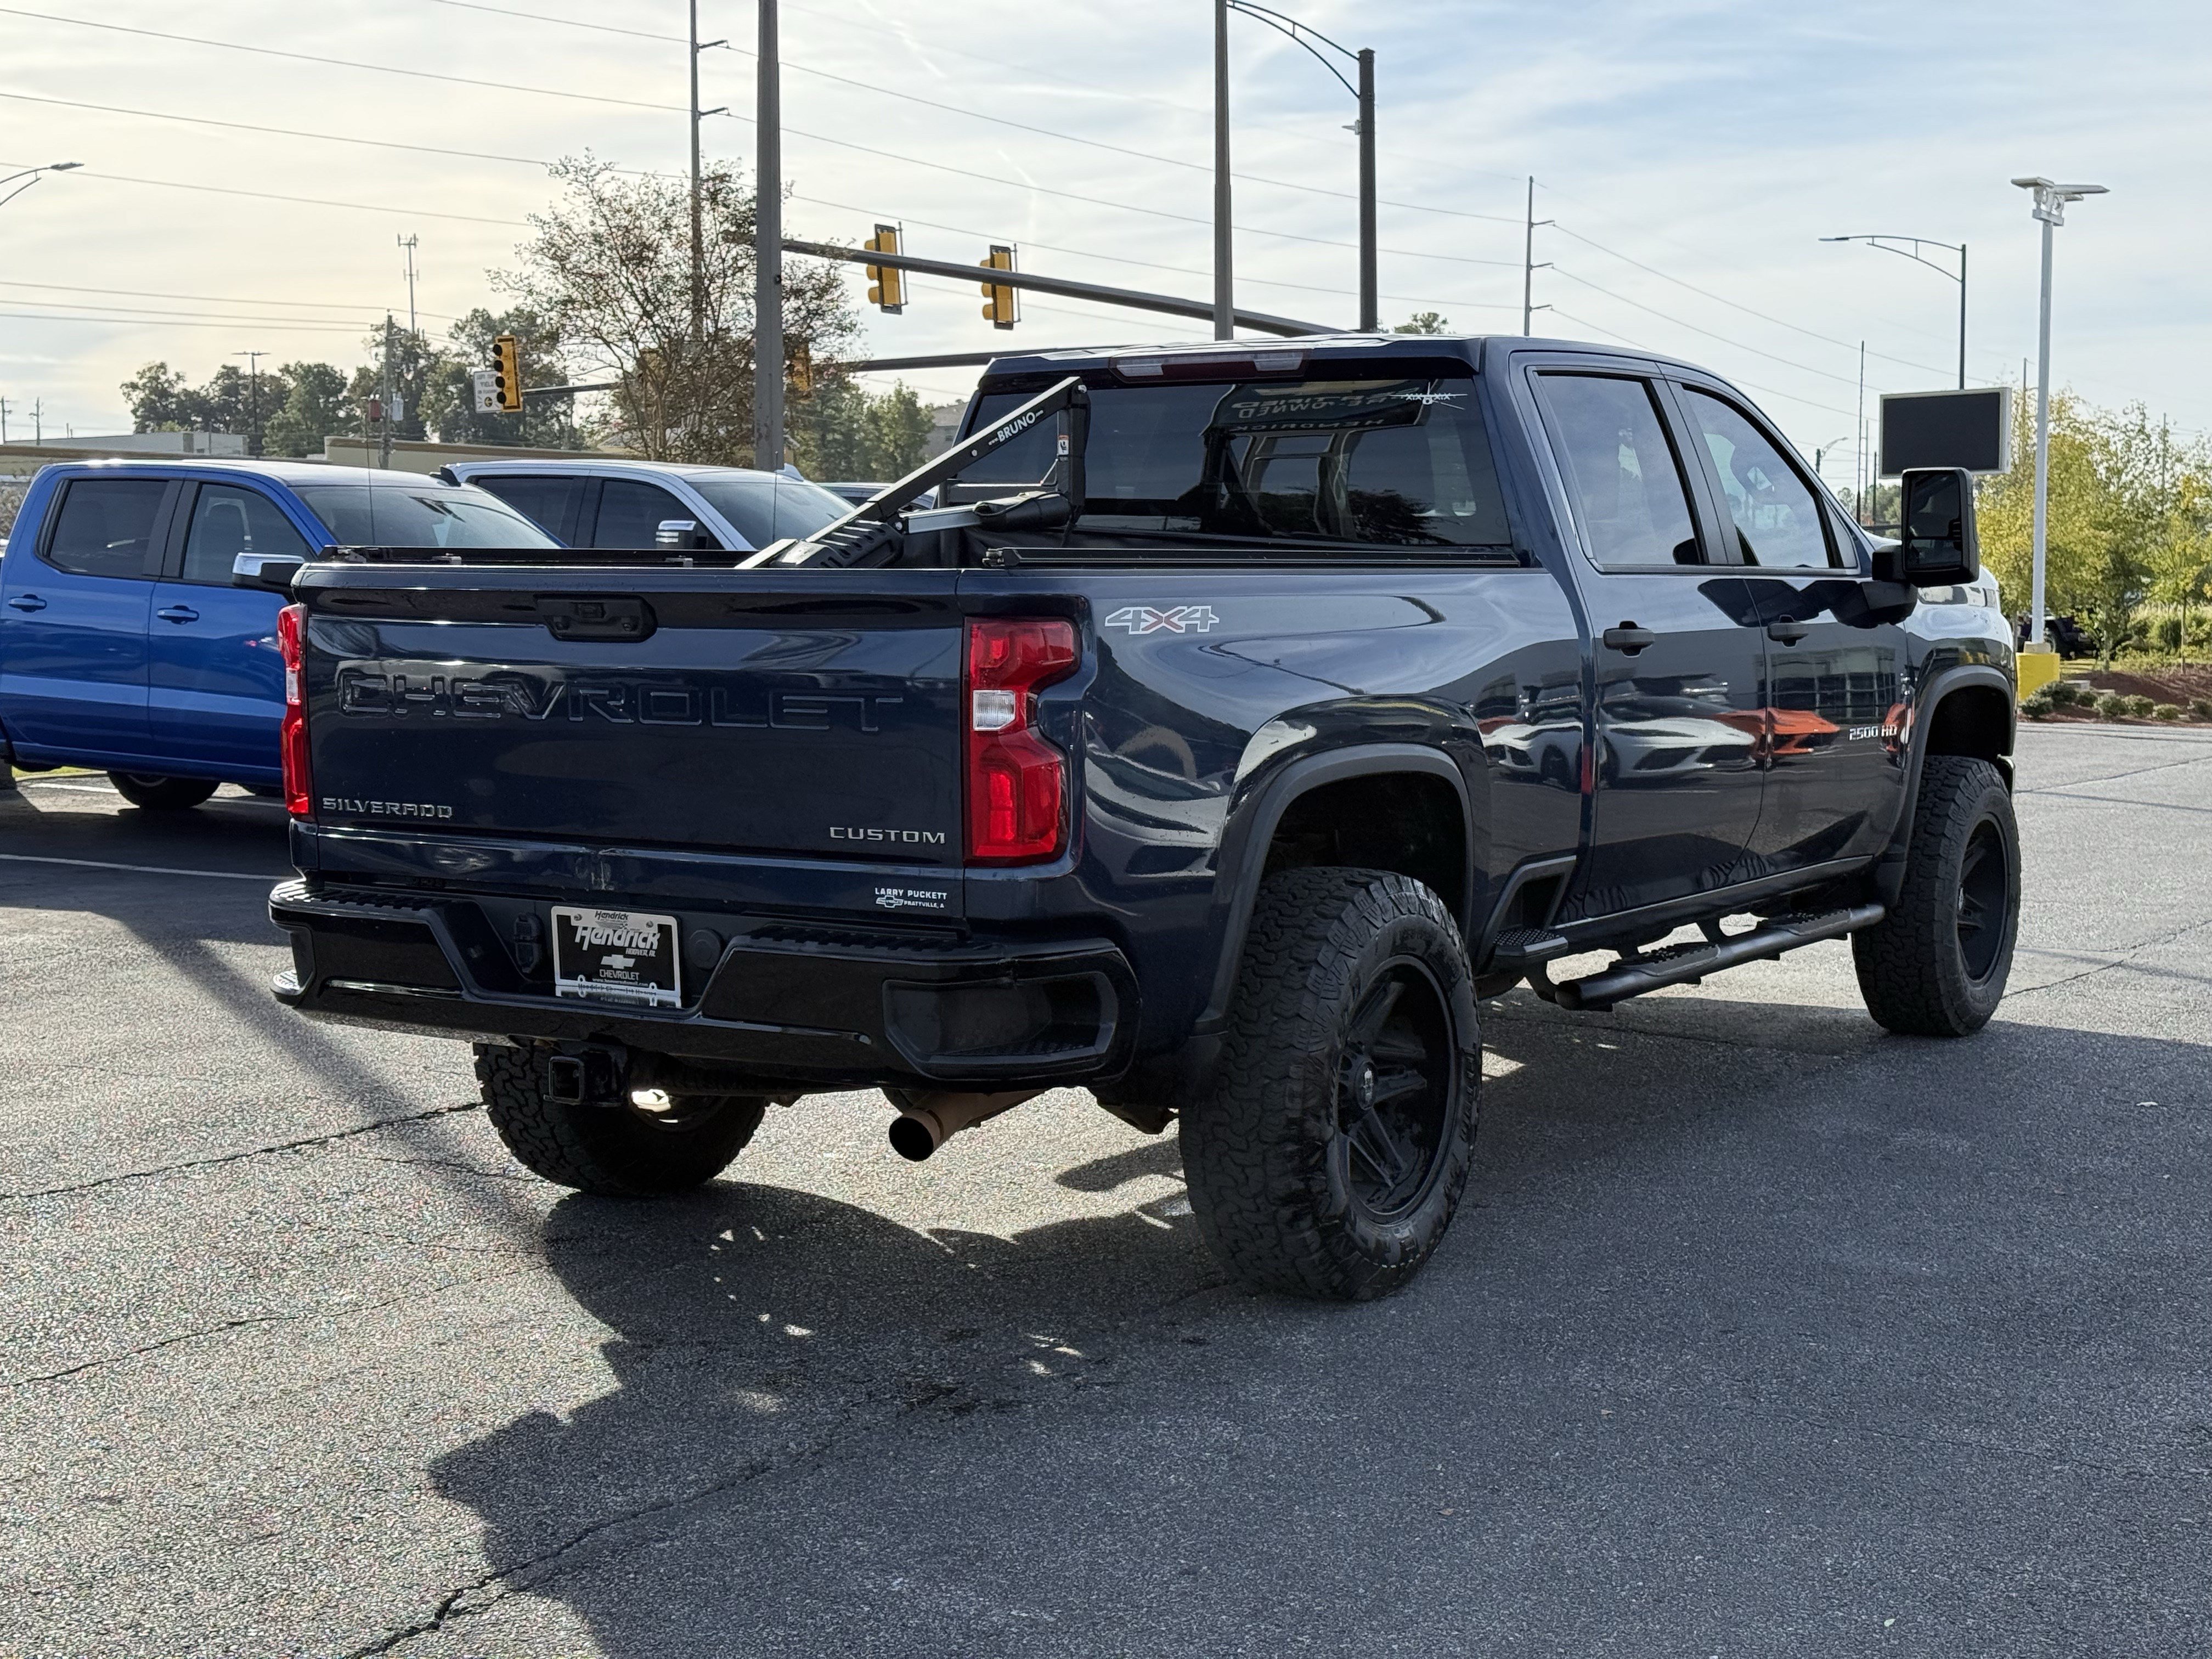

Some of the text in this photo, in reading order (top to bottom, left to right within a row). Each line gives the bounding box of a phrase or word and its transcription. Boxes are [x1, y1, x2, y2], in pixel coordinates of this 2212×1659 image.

[339, 673, 904, 732] CHEVROLET
[1849, 724, 1898, 741] 2500 HD
[323, 798, 453, 819] SILVERADO
[830, 827, 945, 844] CUSTOM
[874, 887, 947, 900] LARRY PUCKETT
[594, 910, 629, 920] Hendrick
[574, 926, 661, 951] Hendrick
[599, 969, 640, 981] CHEVROLET
